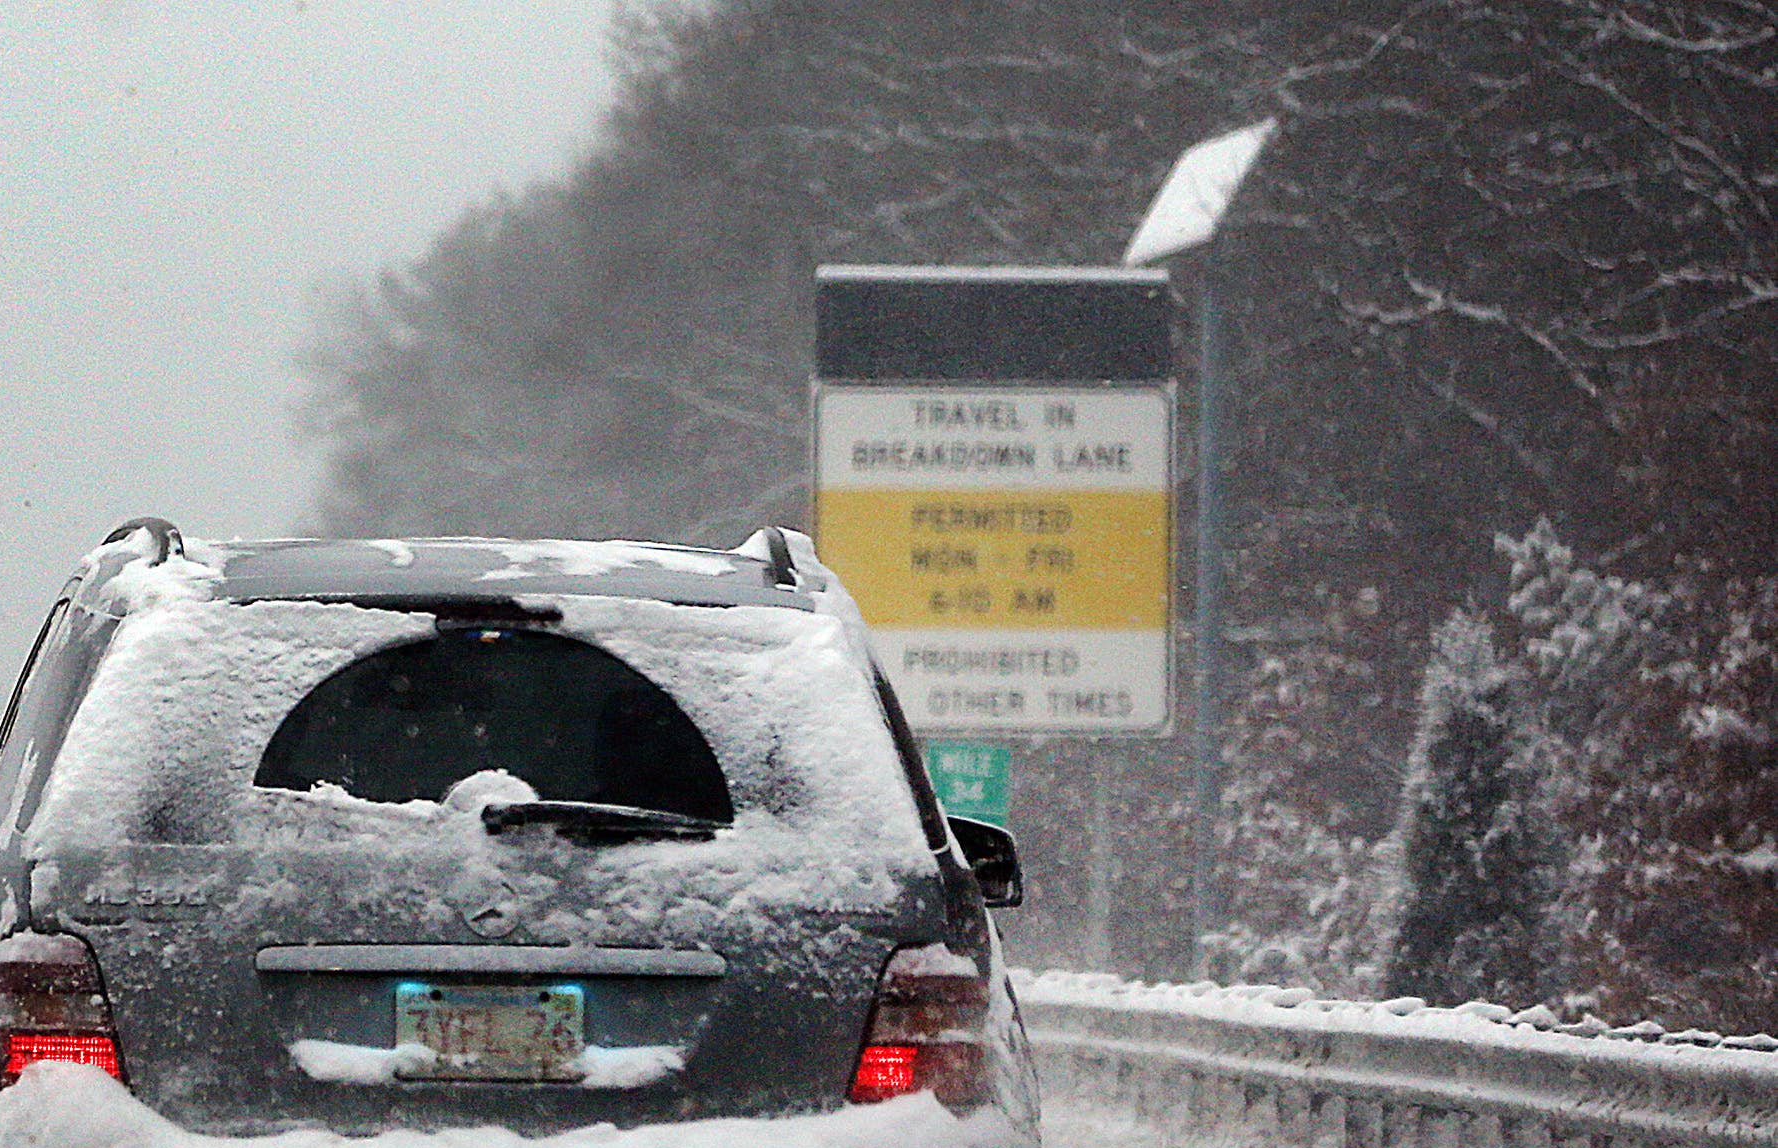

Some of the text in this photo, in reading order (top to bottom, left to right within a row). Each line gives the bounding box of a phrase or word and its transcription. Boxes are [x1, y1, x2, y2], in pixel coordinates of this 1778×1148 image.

[914, 400, 1076, 431] TRAVEL IN
[852, 441, 1133, 473] BREAKDOWN LANE
[911, 504, 1073, 534] PERMITTED
[911, 543, 977, 573] MON
[1026, 544, 1075, 574] FRI
[1010, 585, 1057, 614] AM
[903, 646, 1080, 676] PROHIBITED
[927, 688, 1133, 719] OTHER TIMES
